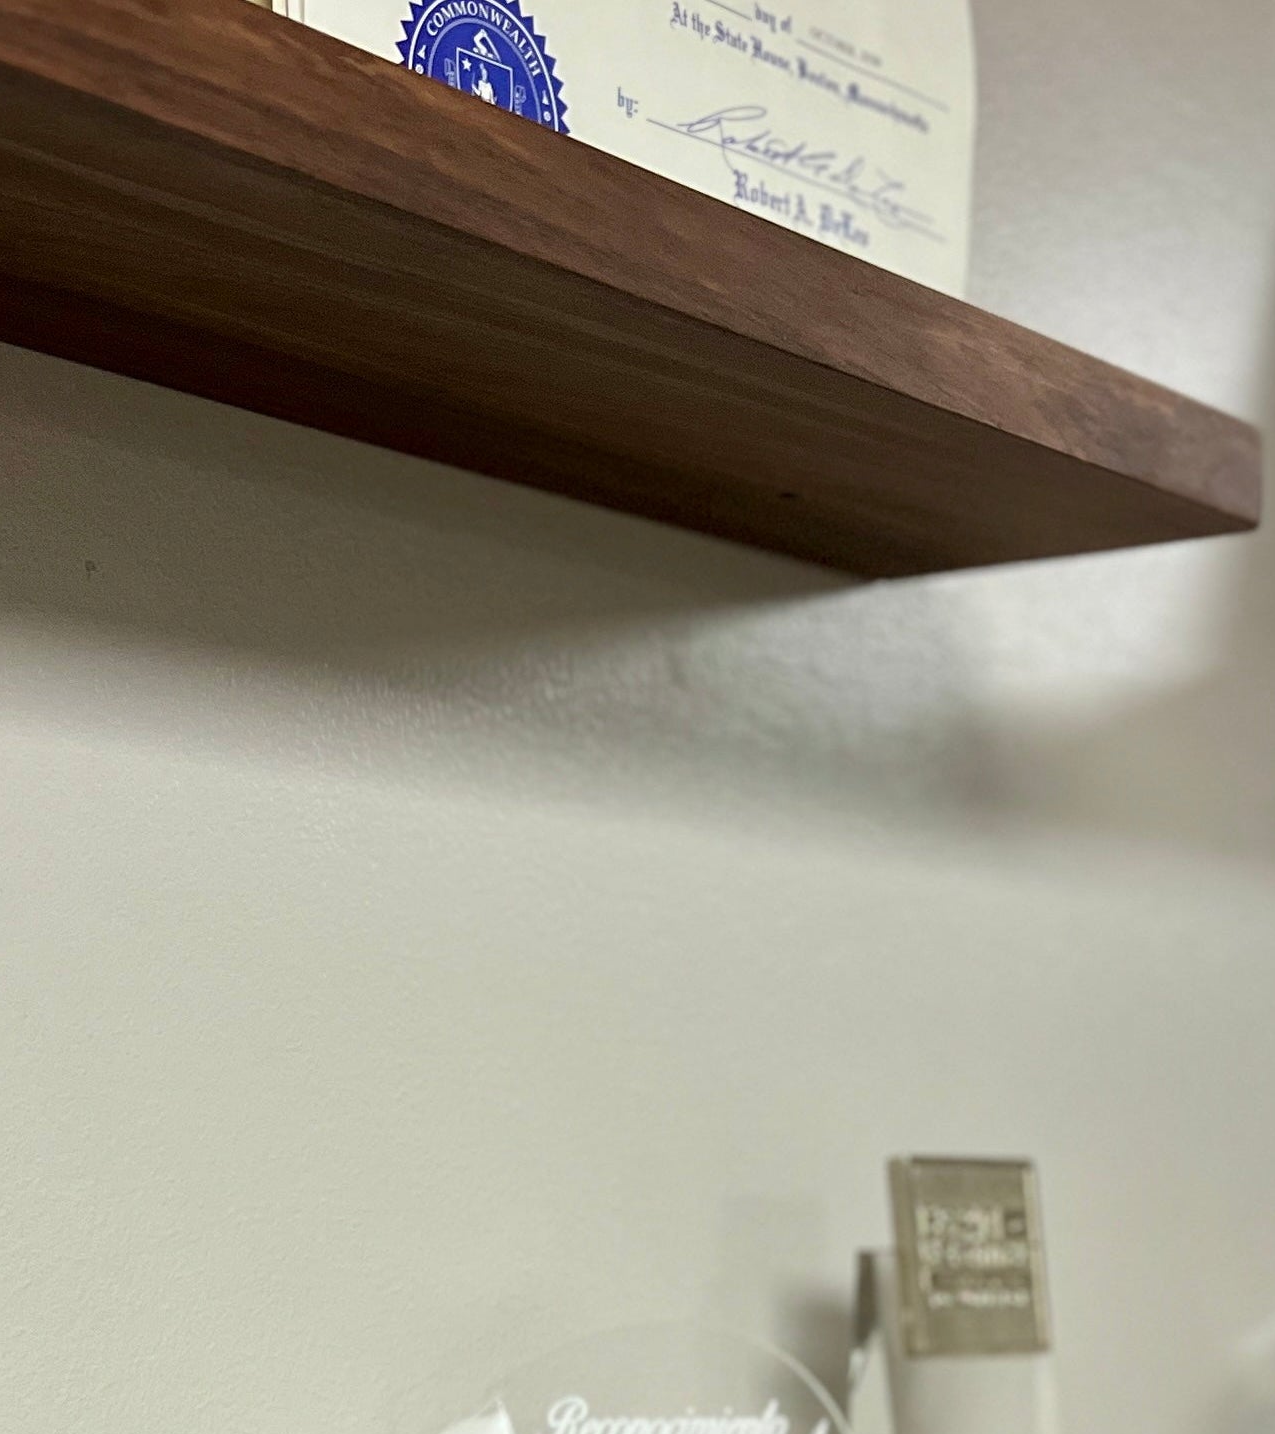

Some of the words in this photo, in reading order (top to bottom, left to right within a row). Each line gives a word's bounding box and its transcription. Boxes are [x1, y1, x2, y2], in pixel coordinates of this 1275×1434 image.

[426, 1, 542, 77] COMMONWEALTH
[670, 1, 687, 28] At
[691, 14, 711, 40] the
[712, 20, 749, 53] State
[617, 86, 639, 118] by:
[732, 169, 793, 215] Robert
